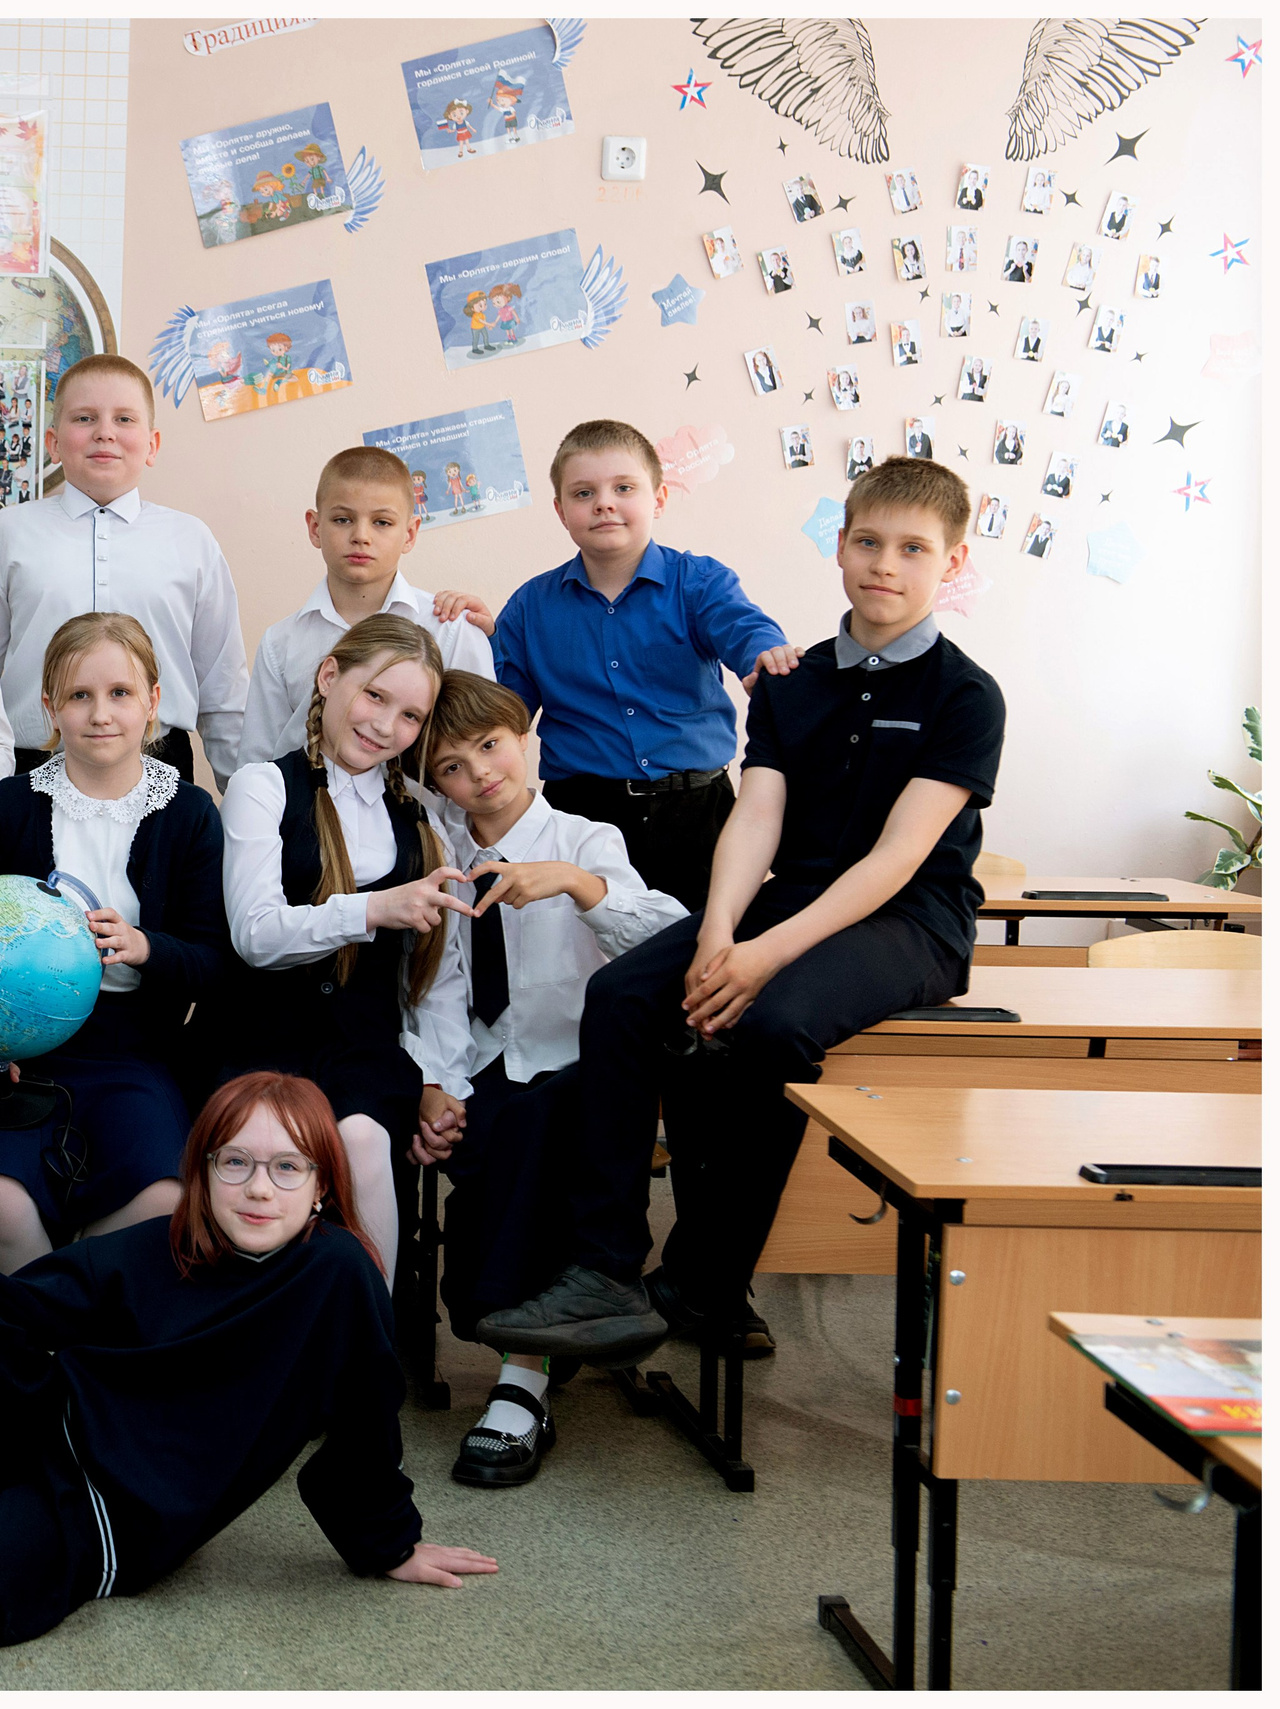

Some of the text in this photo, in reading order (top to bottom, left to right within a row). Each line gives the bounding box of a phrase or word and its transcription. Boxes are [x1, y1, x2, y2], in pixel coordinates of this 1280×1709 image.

[184, 18, 318, 55] Традиция
[414, 65, 431, 79] Мы
[416, 51, 537, 89] гордимся своей Родиной!
[230, 148, 238, 156] и
[275, 129, 311, 144] делаем
[235, 152, 261, 166] дела!
[439, 274, 457, 284] Мы
[502, 253, 539, 269] держим
[540, 244, 571, 260] слово!
[660, 286, 693, 310] Мечтай
[194, 318, 211, 330] Мы
[256, 299, 288, 313] всегда
[249, 312, 286, 328] учиться
[287, 300, 325, 317] новому!
[375, 439, 391, 448] Мы
[430, 421, 468, 437] уважаем
[468, 412, 506, 427] старших,
[387, 440, 422, 454] ботимся
[429, 429, 470, 446] младших!
[685, 438, 720, 460] Орлята
